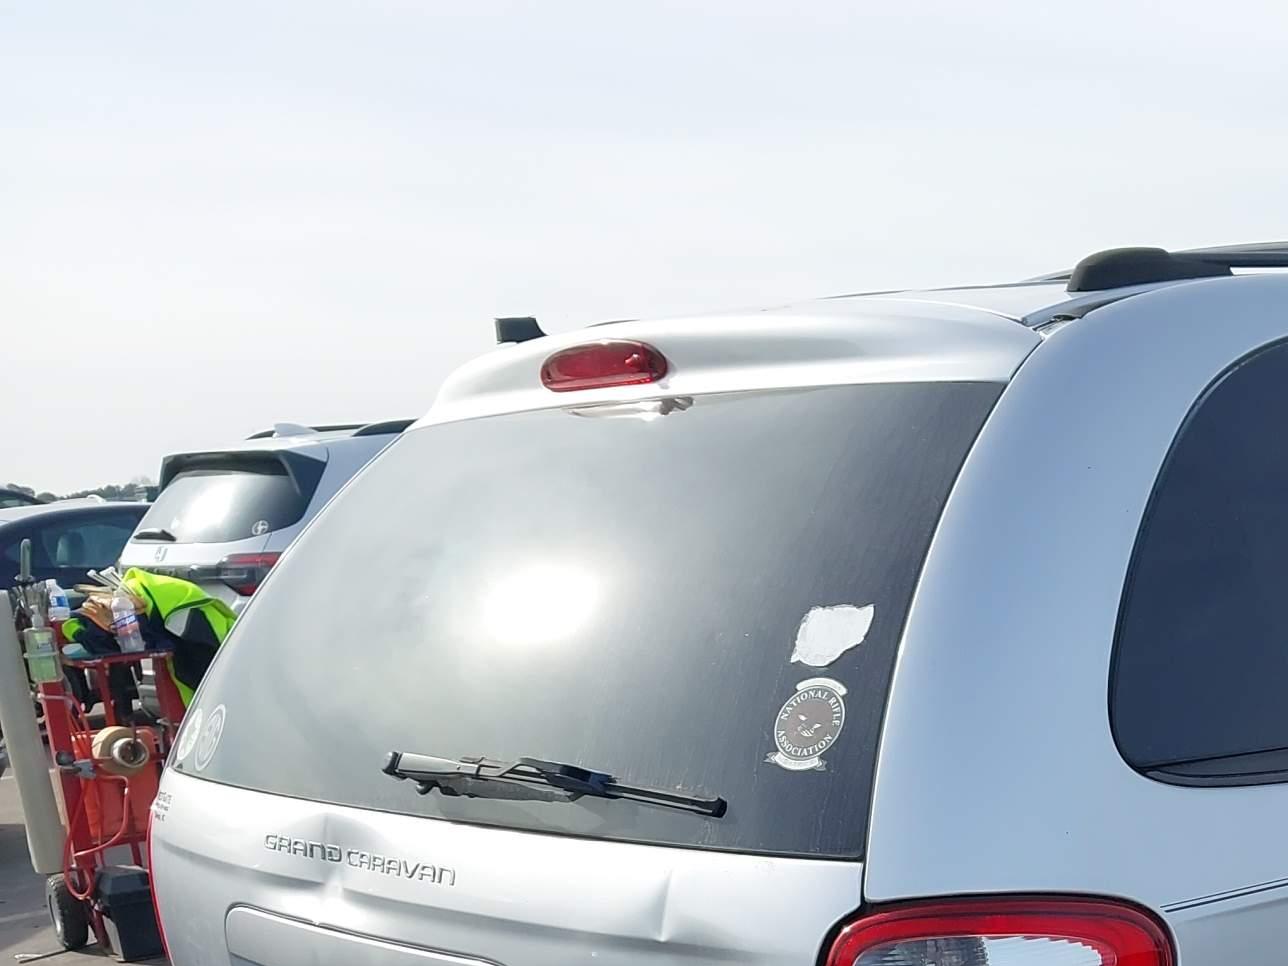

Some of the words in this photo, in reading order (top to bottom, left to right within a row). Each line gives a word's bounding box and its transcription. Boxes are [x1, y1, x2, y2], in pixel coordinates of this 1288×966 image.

[781, 689, 828, 721] NATIONAL
[828, 691, 841, 727] RIFLE
[777, 729, 833, 756] ASSOCIATION
[264, 833, 342, 863] GRAND
[346, 848, 456, 886] CARAVAN
